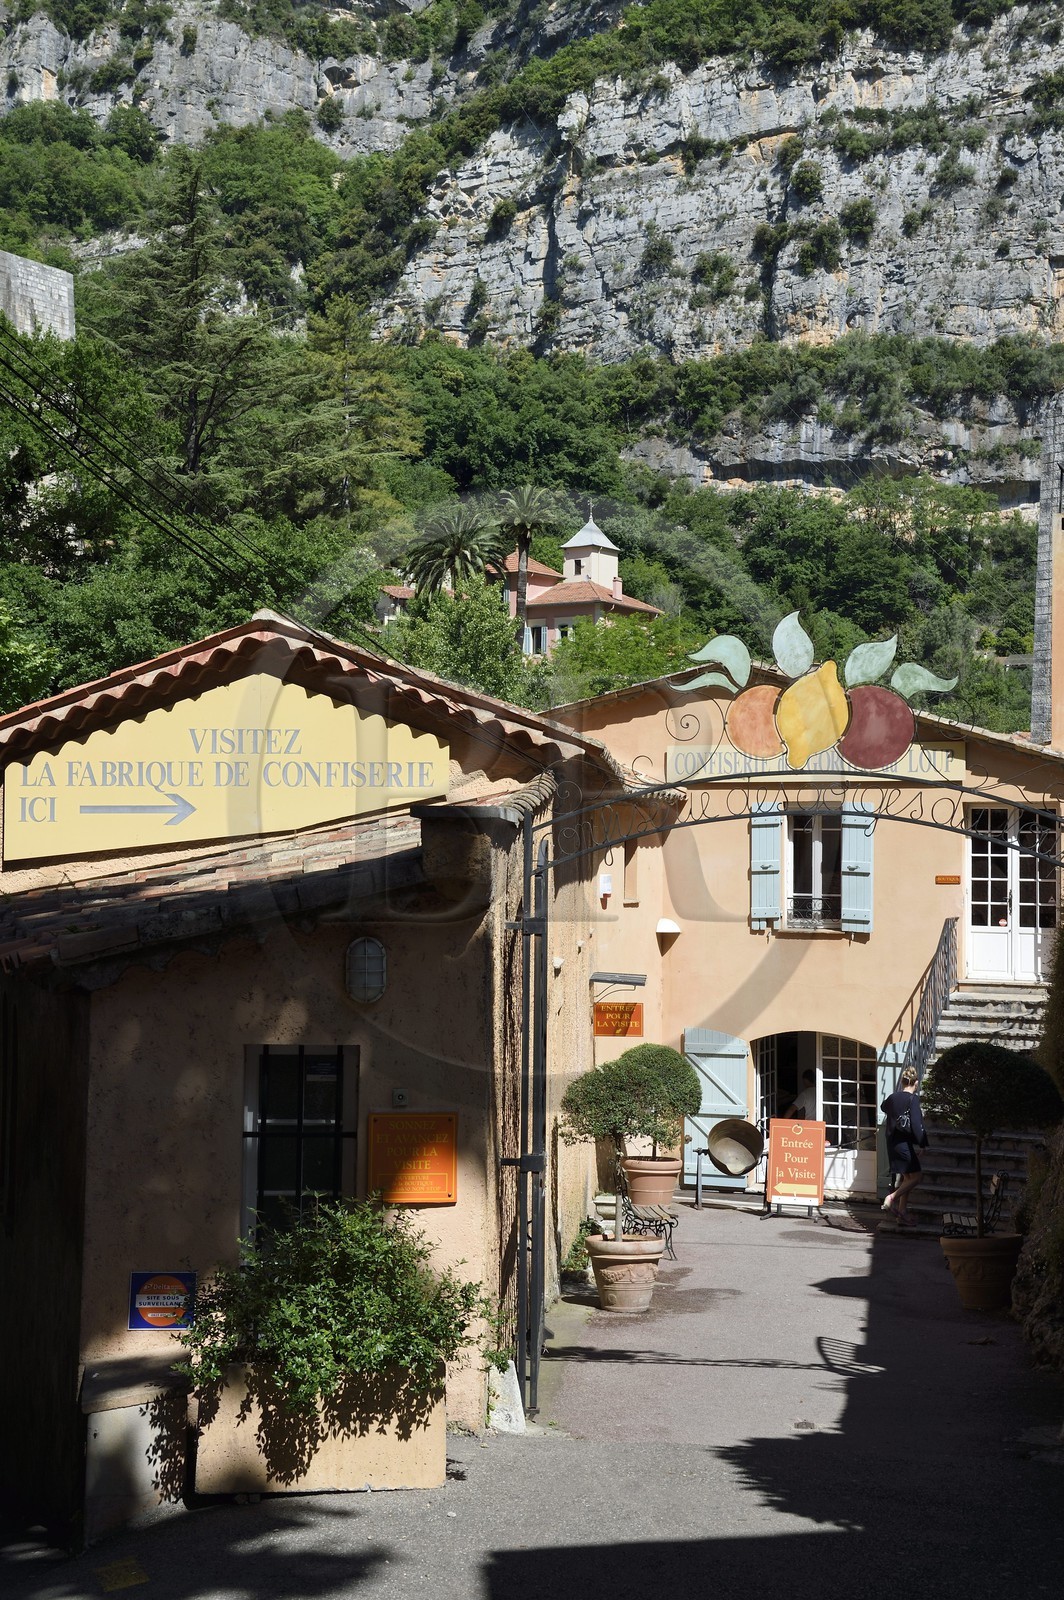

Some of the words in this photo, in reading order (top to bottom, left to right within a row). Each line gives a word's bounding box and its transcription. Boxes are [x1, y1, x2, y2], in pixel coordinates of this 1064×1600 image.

[189, 728, 302, 755] VISITEZ
[674, 751, 771, 776] CONFISERIE
[908, 749, 954, 773] LOUP
[19, 764, 57, 788] LA
[66, 761, 205, 793] FABRIQUE
[214, 761, 250, 787] DE
[263, 761, 435, 788] CONFISERIE
[19, 797, 56, 823] ICI
[389, 1120, 437, 1130] SONNEZ
[376, 1134, 391, 1144] ET
[394, 1134, 449, 1144] AVANCEZ
[781, 1137, 814, 1149] Entrée
[386, 1147, 420, 1156] POUR
[423, 1147, 438, 1156] LA
[784, 1152, 808, 1164] Pour
[394, 1160, 432, 1169] VISITE
[776, 1167, 784, 1178] la
[788, 1168, 816, 1179] Visite
